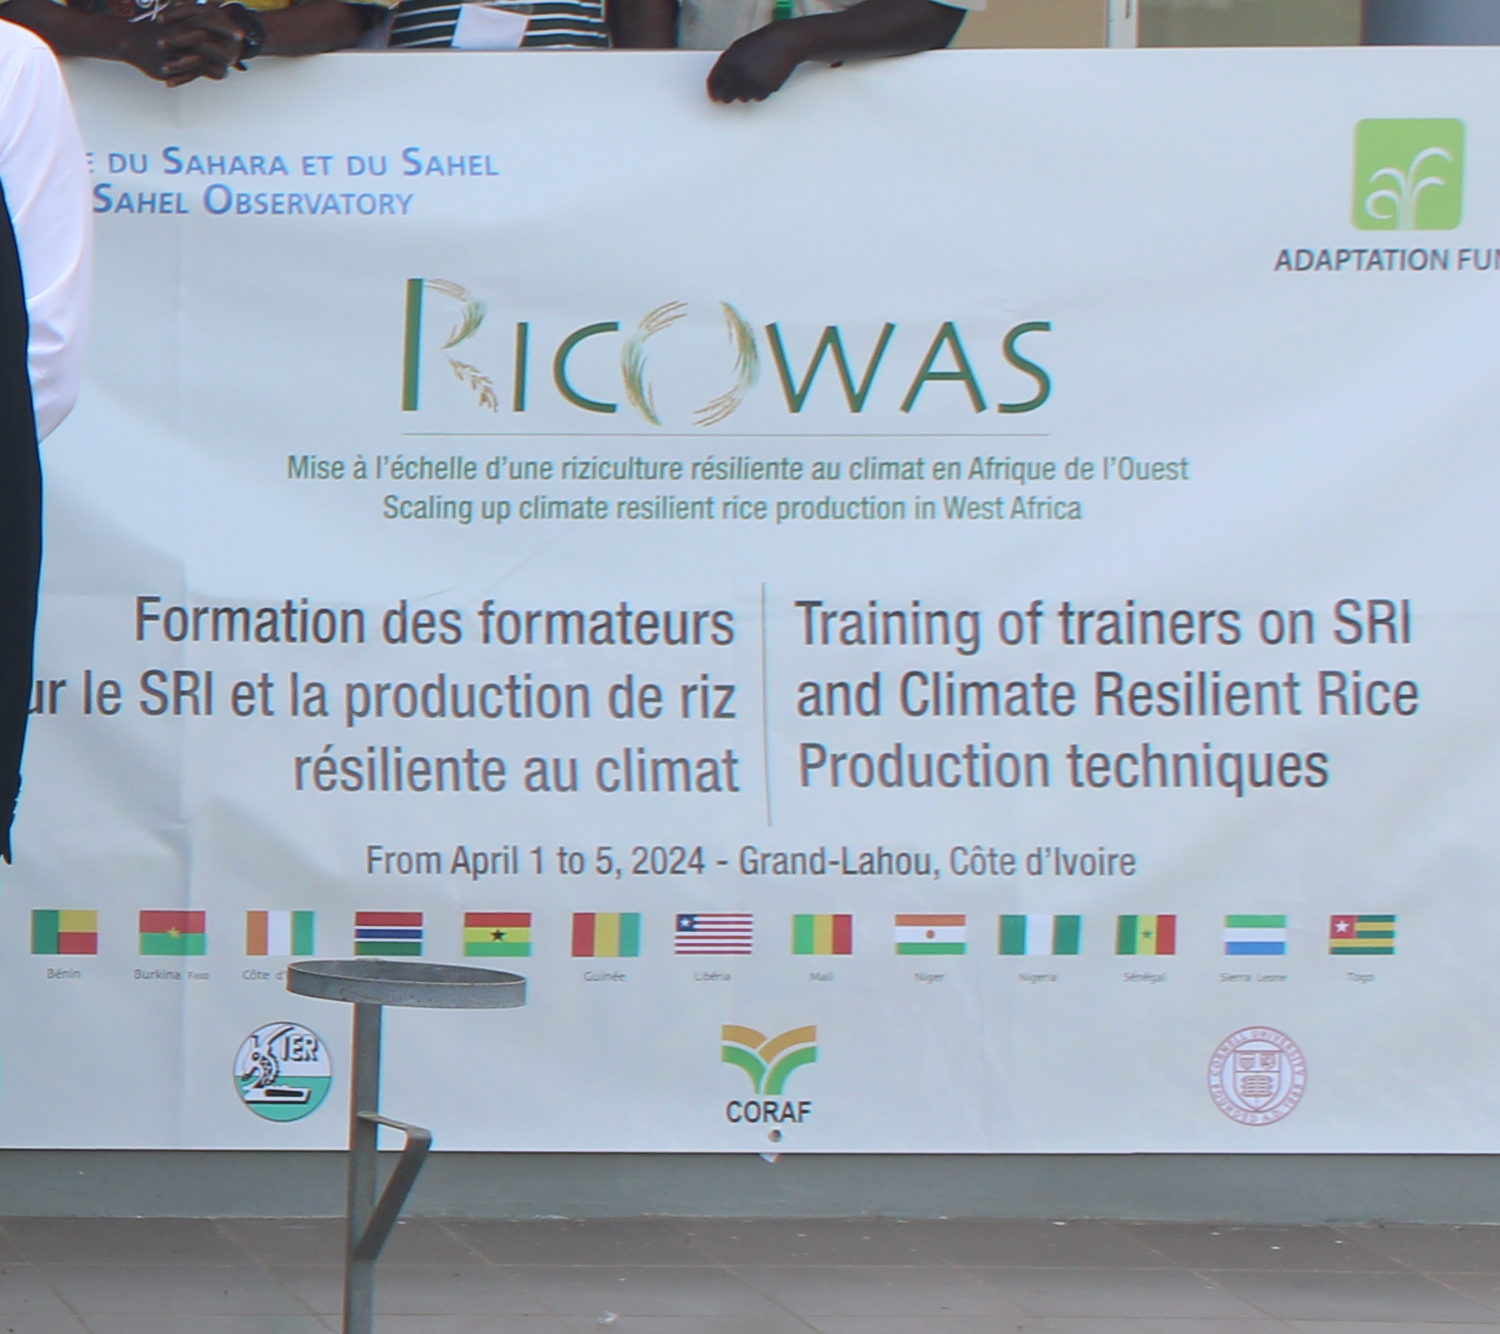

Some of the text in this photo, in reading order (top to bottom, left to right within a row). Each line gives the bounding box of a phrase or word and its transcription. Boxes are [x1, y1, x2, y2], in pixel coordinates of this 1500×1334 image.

[107, 153, 148, 177] DU
[162, 146, 289, 175] SAHARA
[303, 156, 334, 175] ET
[347, 156, 387, 177] DU
[402, 147, 499, 176] SAHEL
[93, 183, 413, 215] SAHEL OBSERVATORY
[1274, 249, 1449, 271] ADAPTATION
[399, 275, 1056, 429] RICOWAS
[288, 455, 1190, 485] Mise à l’échelle d’une riziculture résiliente au climat en Afrique de l’Ouest
[383, 495, 1083, 525] Scaling up climate resilient rice production in West Africa
[136, 596, 735, 645] Formation des formateurs
[794, 599, 1411, 656] Training of trainers on SRI
[83, 670, 121, 715] le
[140, 670, 213, 715] SRI
[231, 673, 275, 716] et
[291, 672, 329, 717] la
[346, 673, 591, 728] production
[608, 674, 663, 719] de
[681, 674, 737, 718] riz
[797, 670, 1419, 716] and Climate Resilient Rice
[295, 744, 741, 793] résiliente au climat
[800, 742, 1330, 797] Production techniques
[367, 846, 442, 874] From
[450, 846, 517, 879] April
[531, 846, 544, 874] 1
[556, 847, 586, 875] to
[596, 847, 622, 879] 5,
[632, 846, 706, 875] 2024
[739, 846, 940, 880] Grand-Lahou,
[950, 845, 1017, 875] Côte
[1026, 847, 1137, 876] d’Ivoire
[47, 969, 80, 979] Bénin
[134, 969, 182, 980] Burkina
[242, 970, 271, 980] Côte
[584, 970, 626, 981] Guinée
[692, 970, 731, 981] Libéria
[809, 973, 834, 981] Mali
[914, 973, 945, 984] Niger
[1019, 974, 1058, 984] Nigeria
[1124, 973, 1166, 984] Sénégal
[1346, 972, 1376, 984] Togo
[280, 1033, 319, 1063] IER
[727, 1101, 811, 1123] CORAF
